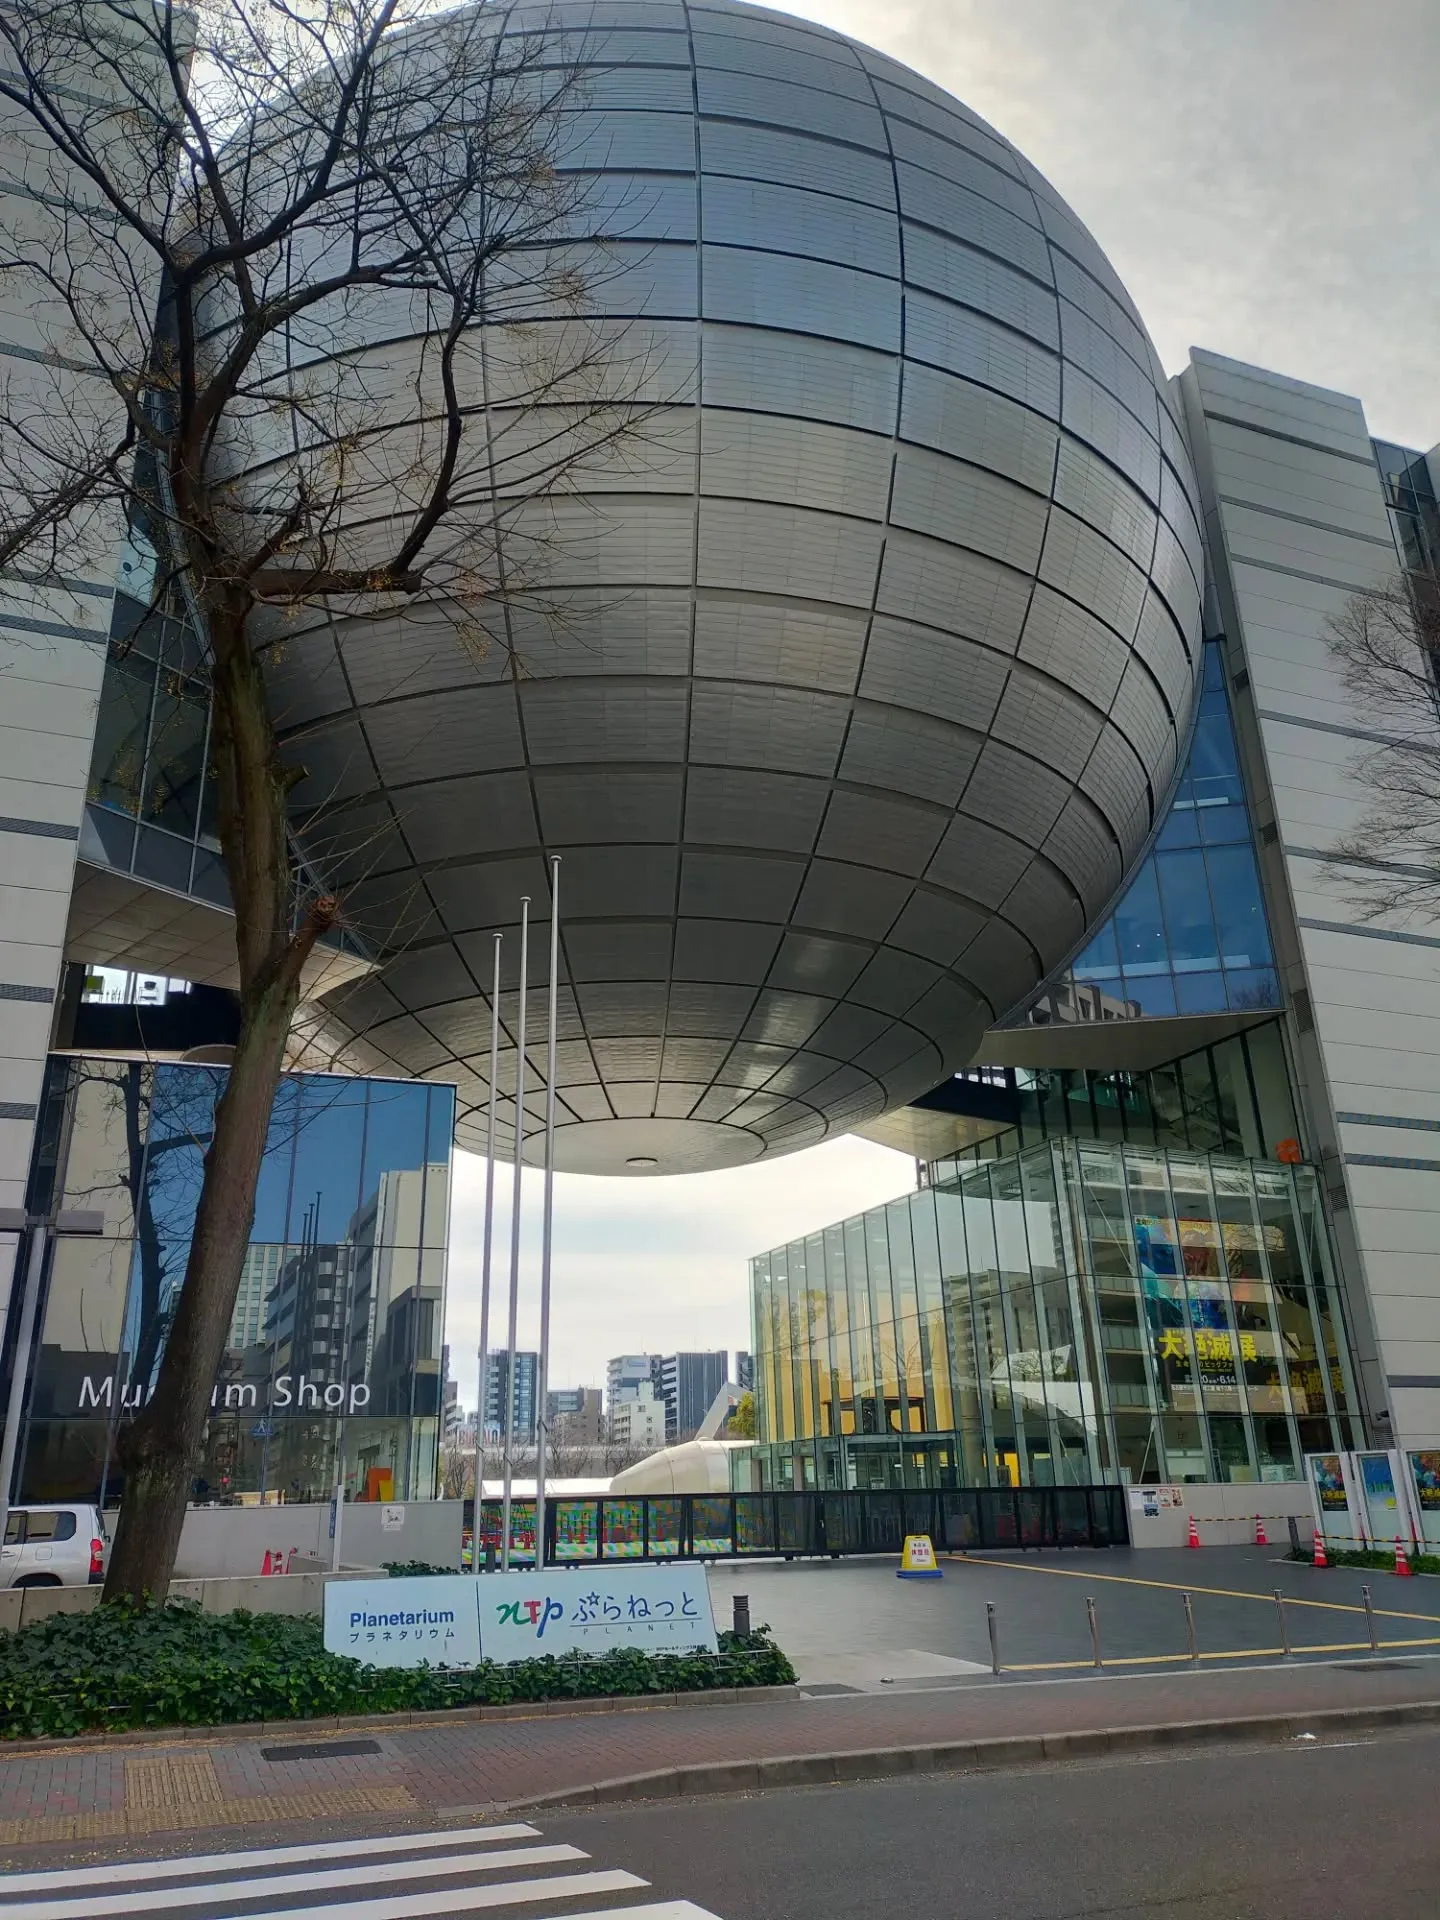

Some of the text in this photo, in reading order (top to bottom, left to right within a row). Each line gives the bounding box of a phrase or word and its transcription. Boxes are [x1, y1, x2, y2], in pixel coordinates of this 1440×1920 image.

[78, 1375, 371, 1414] Mum Shop
[572, 1591, 698, 1621] ぷらねっと
[350, 1609, 455, 1628] Planetarium
[349, 1628, 455, 1644] プラネタリウム
[583, 1622, 695, 1636] PLANET
